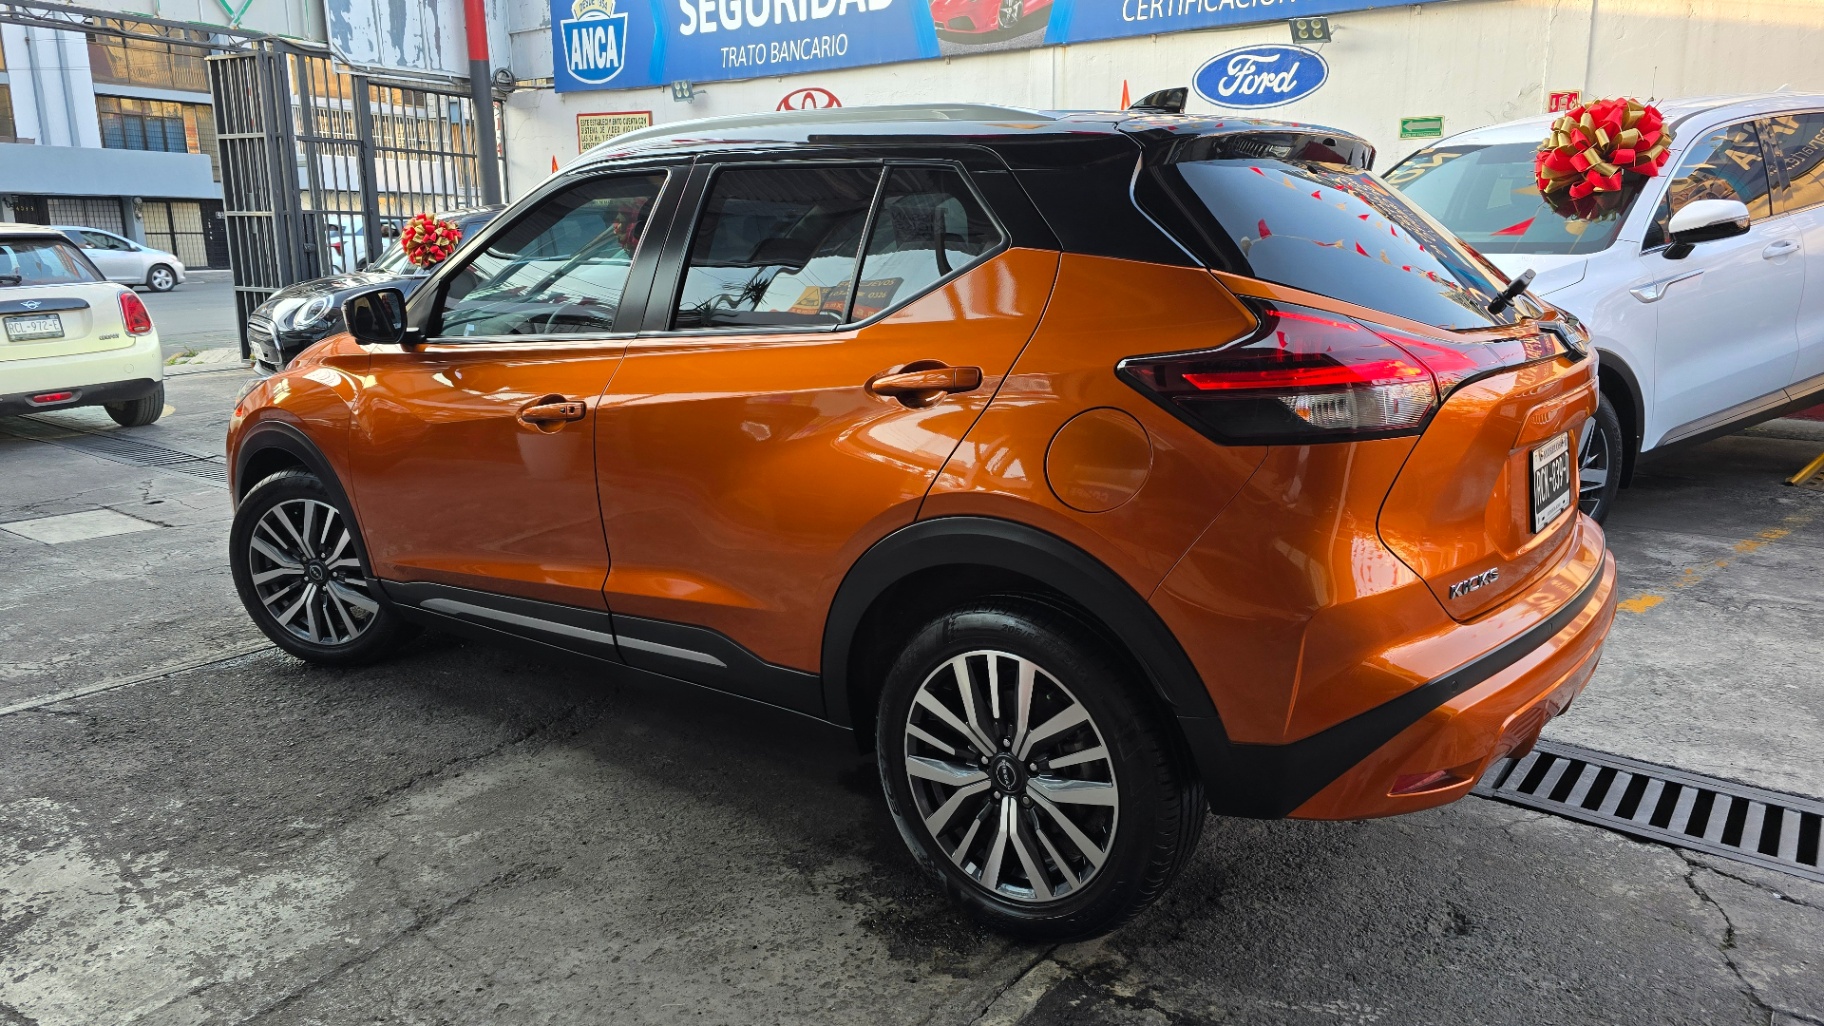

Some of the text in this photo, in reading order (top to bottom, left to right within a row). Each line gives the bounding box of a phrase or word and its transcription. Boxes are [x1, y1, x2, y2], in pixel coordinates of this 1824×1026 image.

[571, 25, 619, 70] ANCA
[721, 33, 848, 68] TRATO BANCARIO
[1218, 54, 1300, 97] Ford
[8, 319, 60, 334] RCL-972-E
[1449, 566, 1499, 600] KICKS
